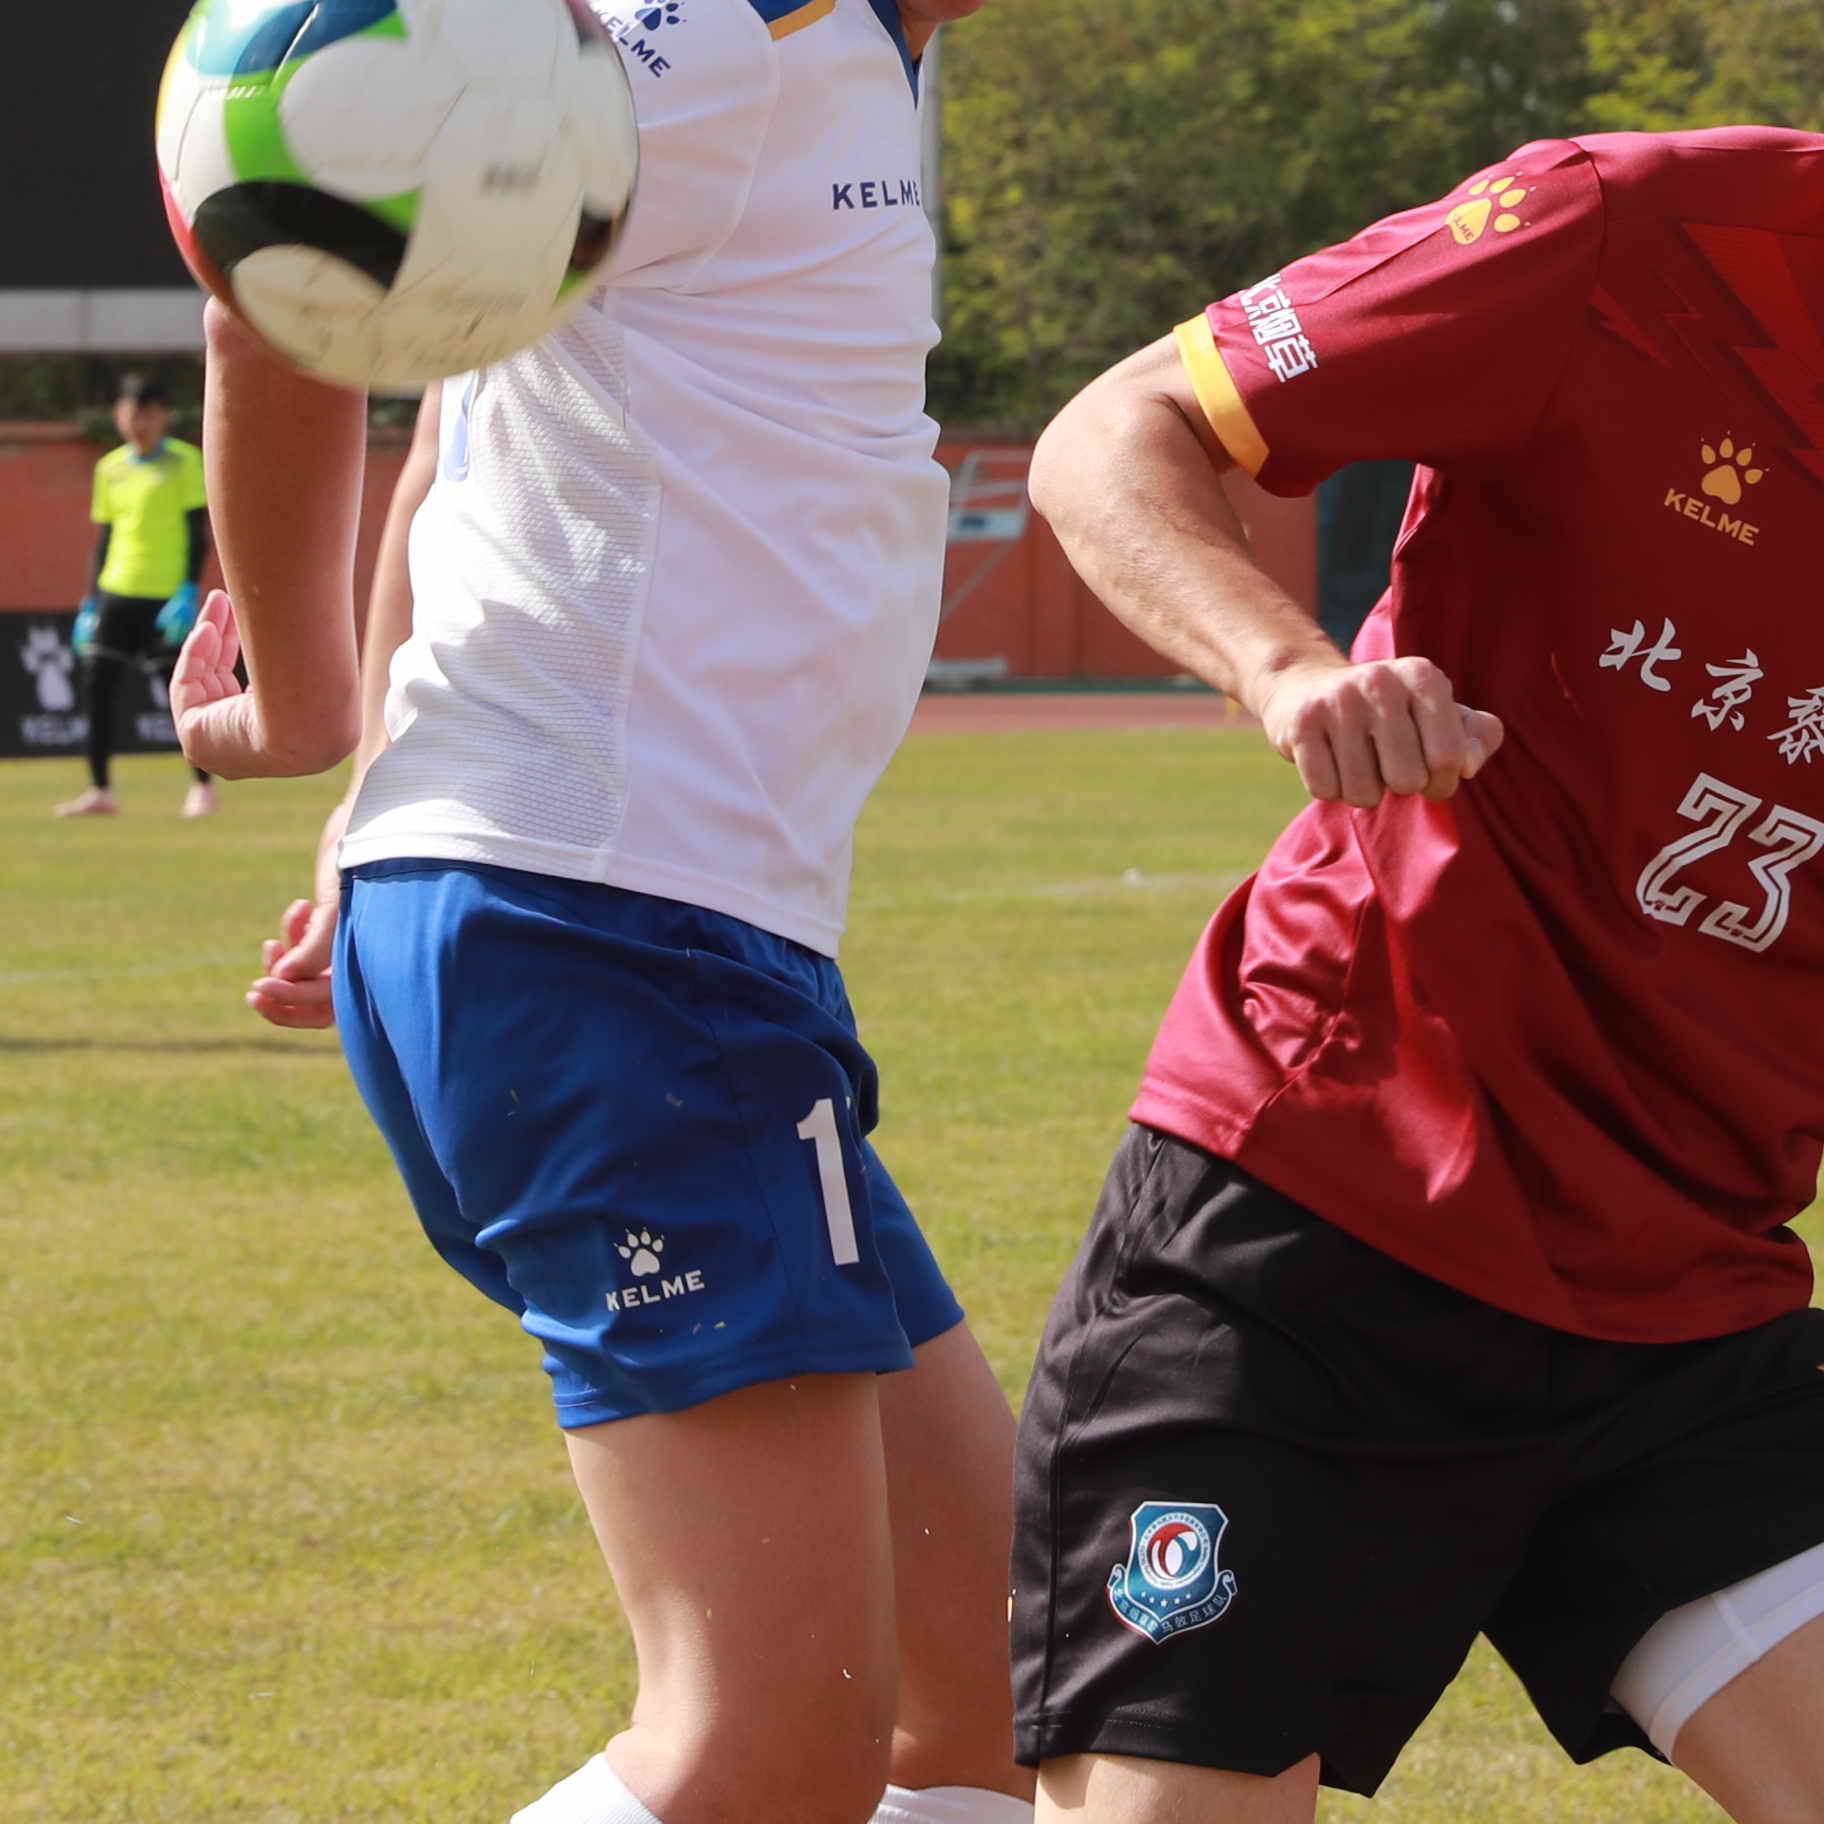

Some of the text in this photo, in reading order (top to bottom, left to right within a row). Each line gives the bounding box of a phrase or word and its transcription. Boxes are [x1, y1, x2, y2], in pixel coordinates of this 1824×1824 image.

[1664, 488, 1759, 546] KELME
[21, 714, 89, 745] KELM
[796, 1098, 859, 1265] 1
[606, 1270, 704, 1312] KELME
